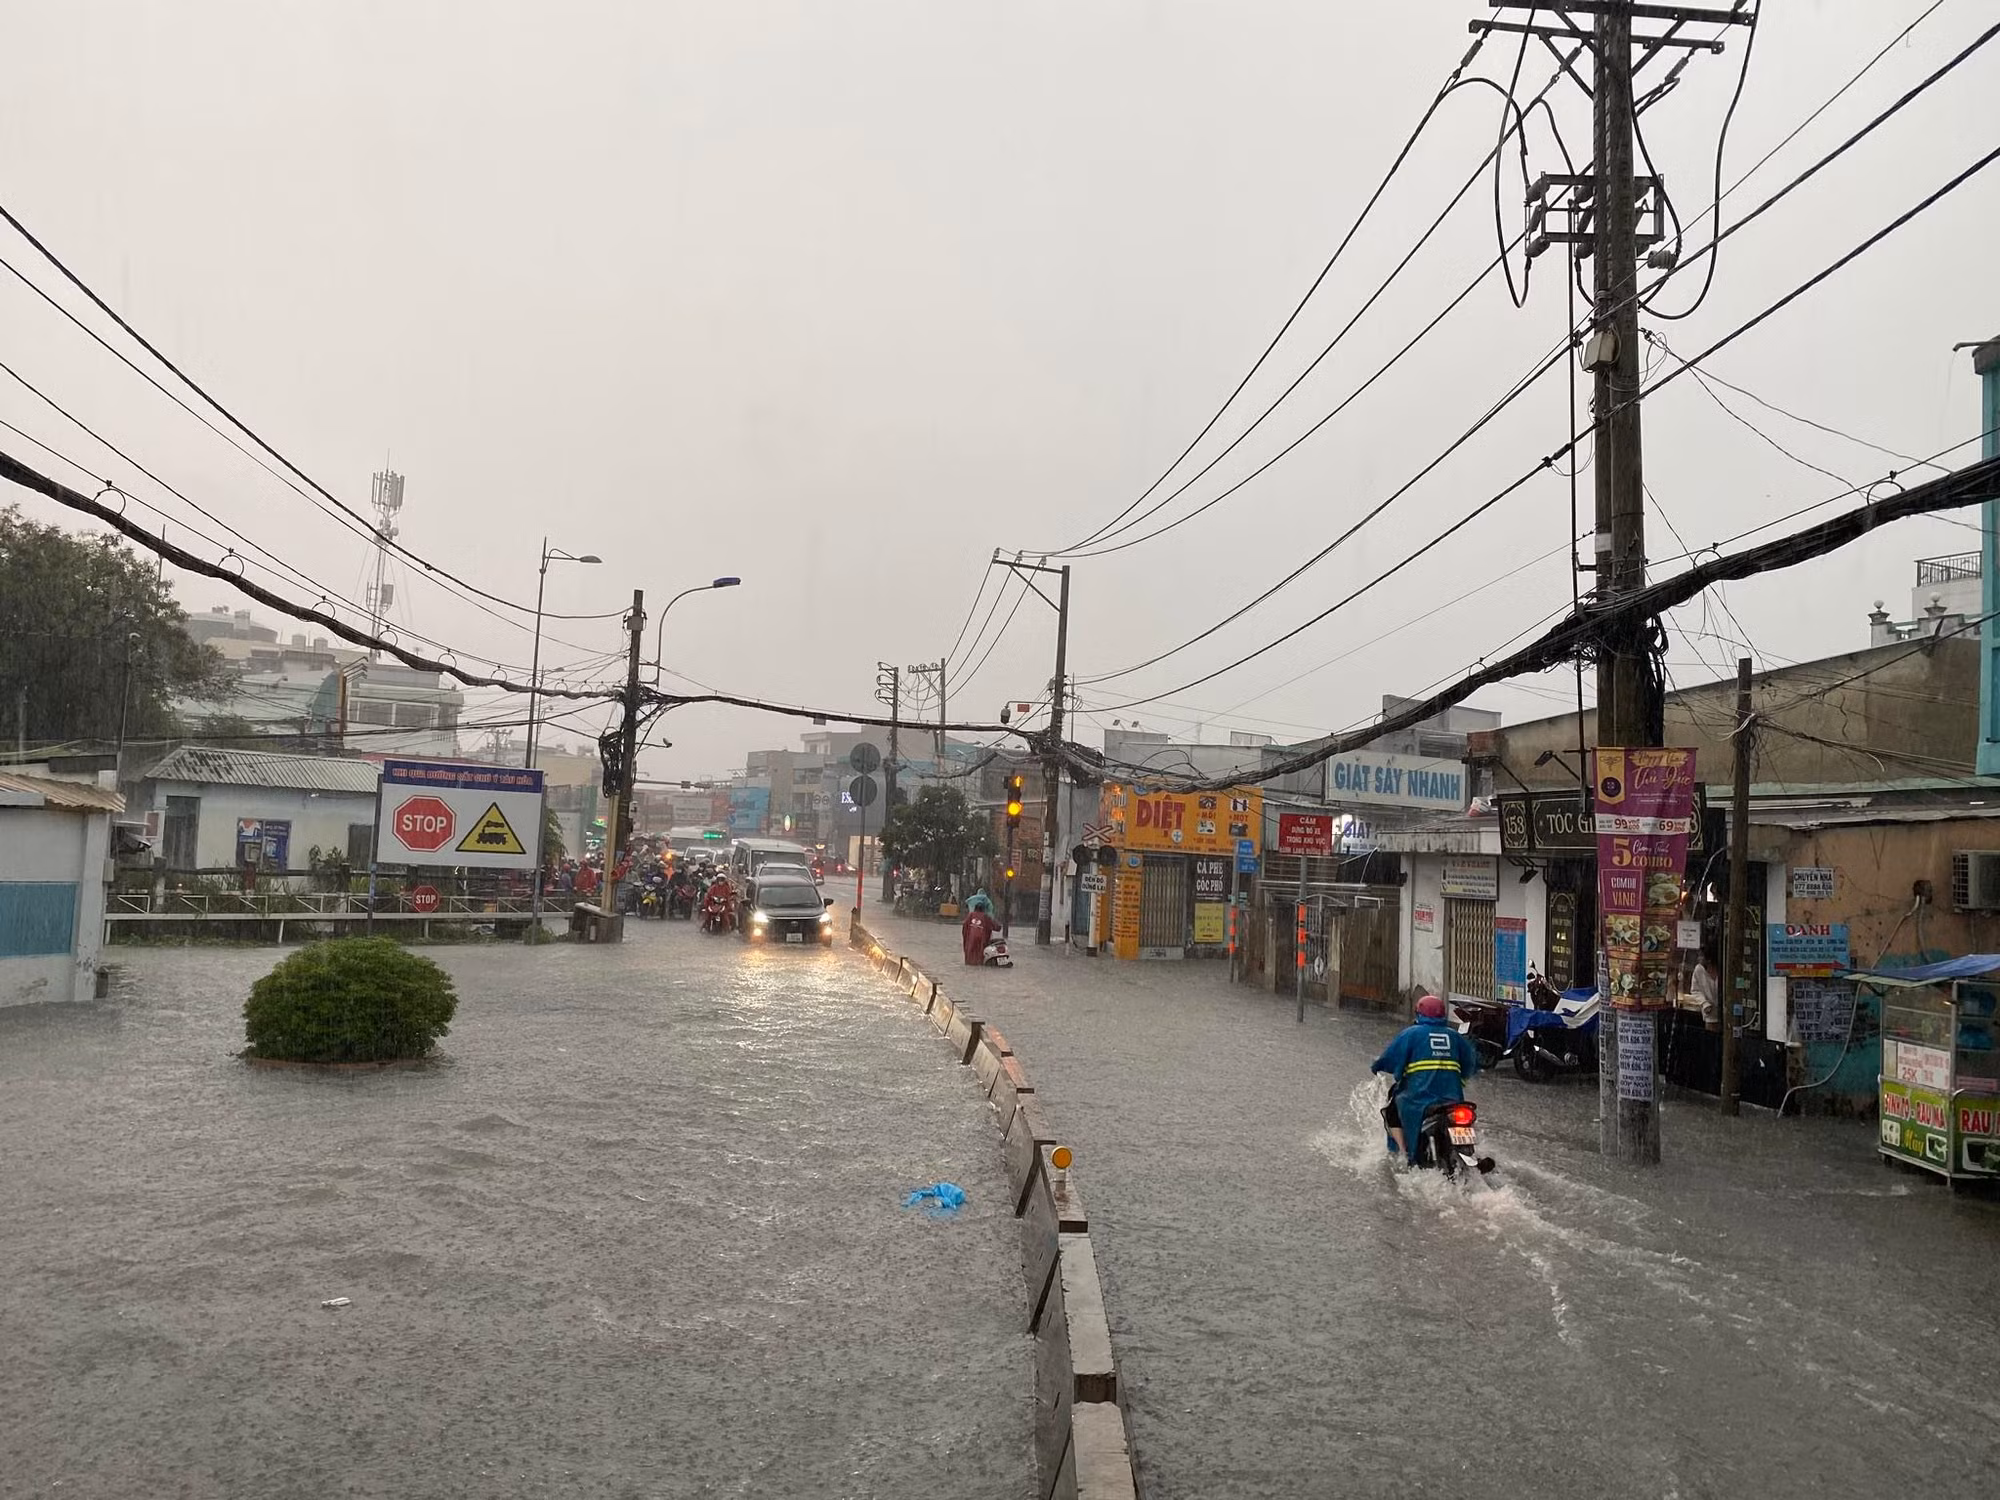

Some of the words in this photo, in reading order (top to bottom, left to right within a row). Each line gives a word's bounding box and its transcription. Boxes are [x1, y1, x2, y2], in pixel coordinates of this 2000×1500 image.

[1334, 756, 1370, 798] GIẶT
[1374, 755, 1403, 795] SẤY
[1408, 769, 1460, 801] NHANH
[402, 815, 447, 833] STOP
[1136, 793, 1186, 838] DIỆT
[1546, 808, 1574, 834] TÓC
[1614, 818, 1628, 830] 99
[1505, 815, 1526, 835] 153
[1659, 820, 1674, 832] 69
[1612, 837, 1632, 867] 5
[1632, 855, 1673, 868] COMBO
[1196, 876, 1210, 892] GÓC
[1210, 874, 1224, 892] PHỐ
[1610, 876, 1637, 889] COMBO
[415, 894, 436, 904] STOP
[1785, 924, 1830, 936] OANH
[1915, 1100, 1931, 1127] RAU
[1959, 1107, 1993, 1136] RAU
